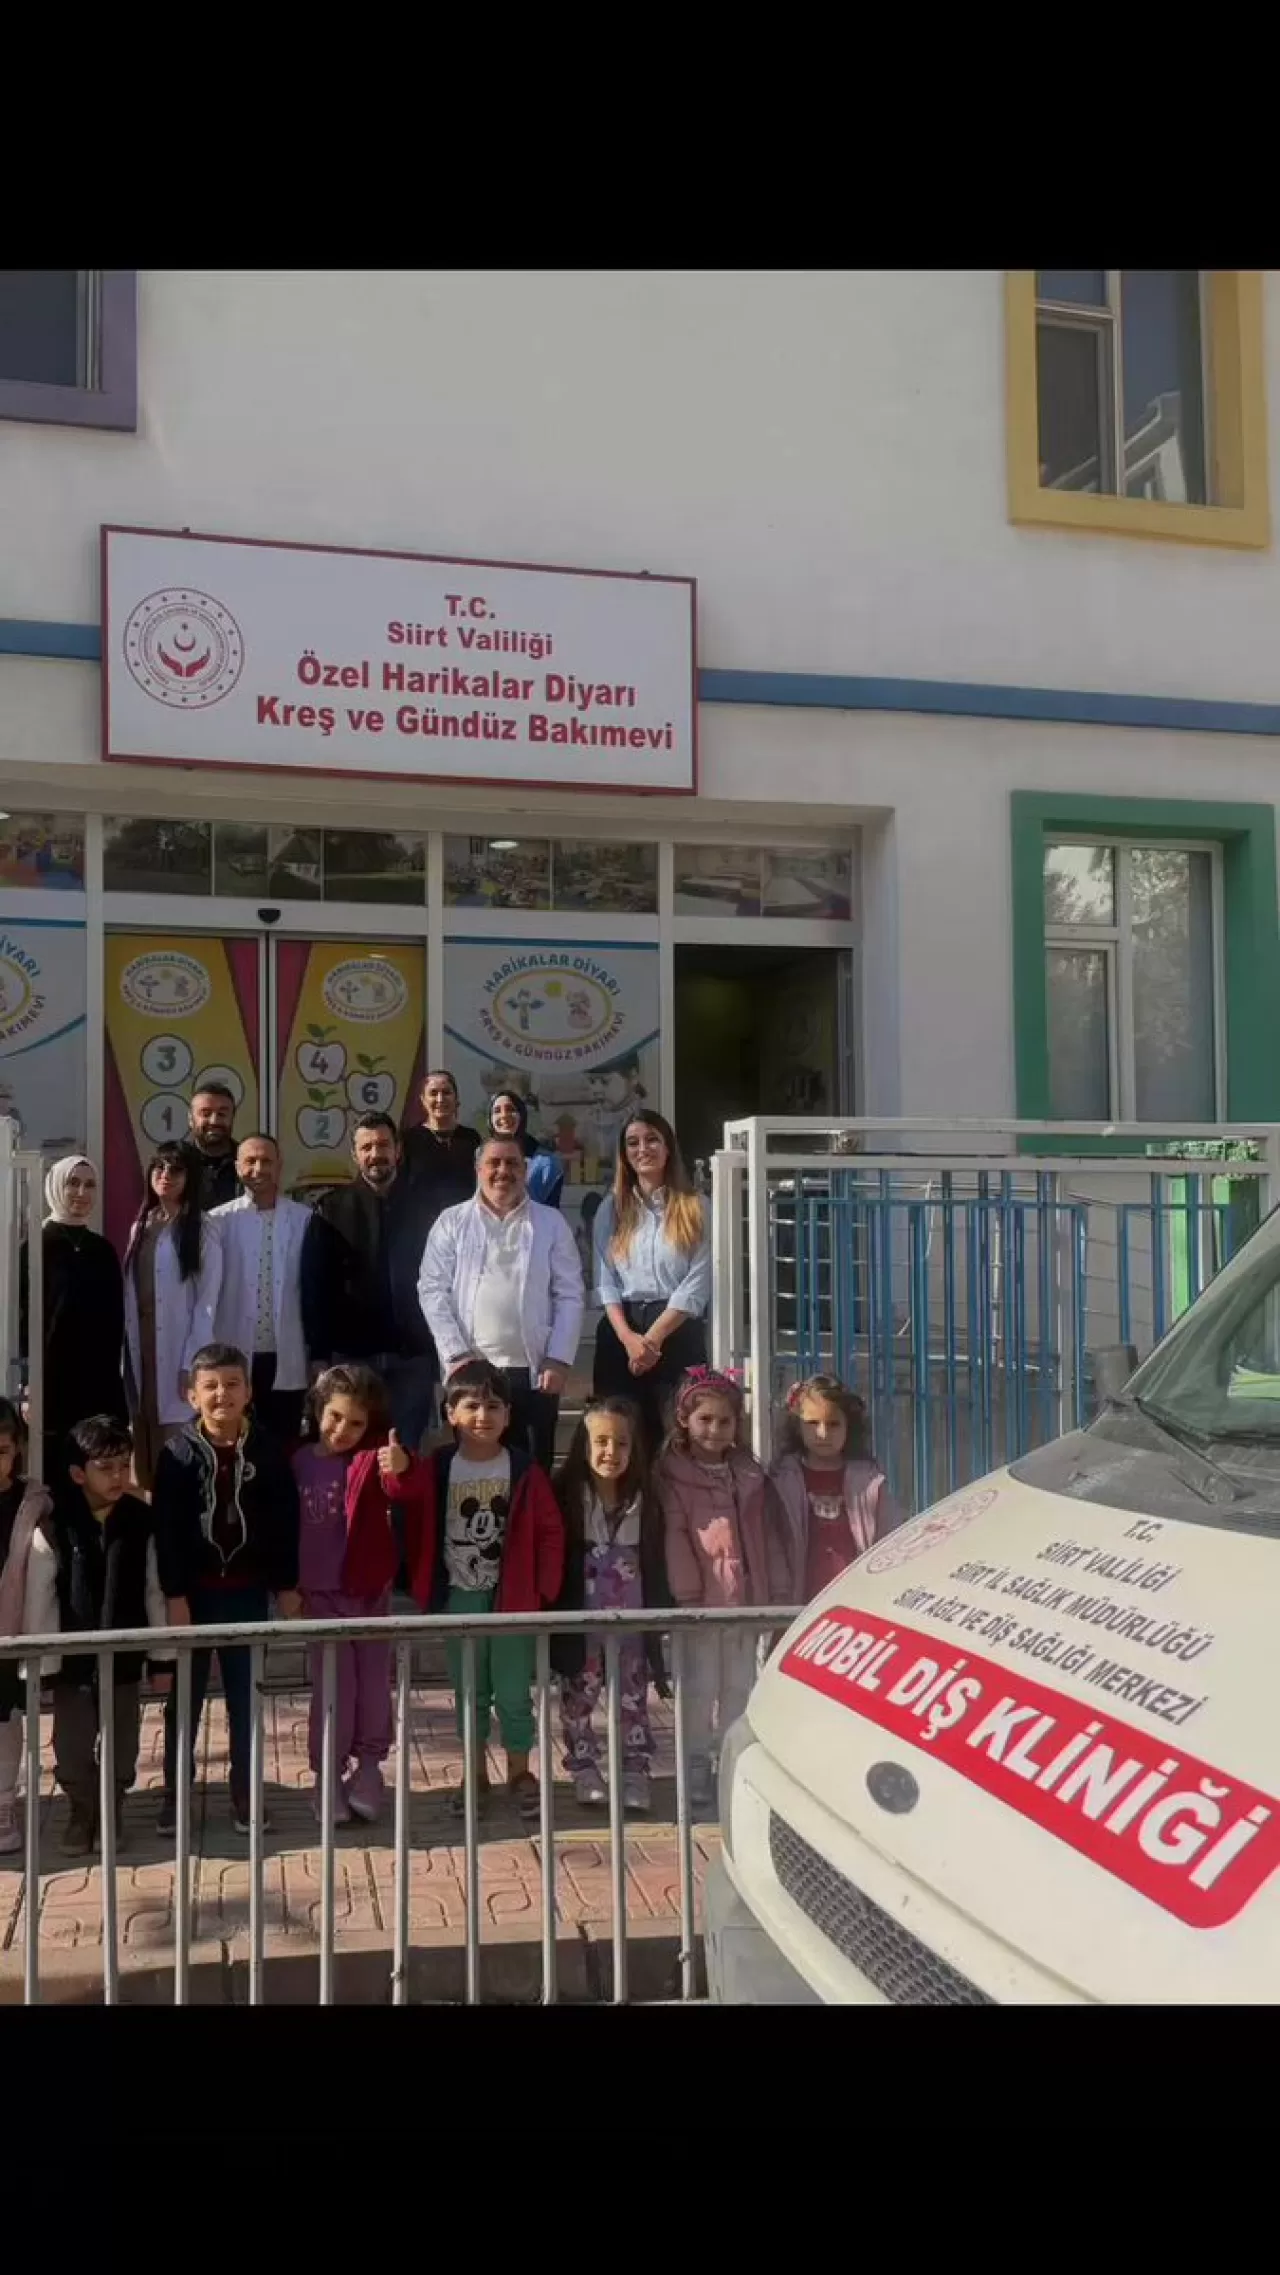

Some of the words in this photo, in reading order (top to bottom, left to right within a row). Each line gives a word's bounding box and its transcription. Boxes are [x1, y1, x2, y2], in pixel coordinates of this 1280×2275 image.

[445, 594, 496, 619] T.C.
[387, 621, 448, 649] Siirt
[457, 626, 553, 660] Valiliği
[297, 650, 370, 691] Özel
[382, 664, 534, 701] Harikalar
[545, 675, 636, 712] Diyarı
[256, 695, 336, 737] Kreş
[348, 710, 384, 734] ve
[397, 704, 517, 741] Gündüz
[528, 714, 674, 750] Bakımevi
[0, 933, 41, 978] İYARI
[483, 953, 570, 993] HARİKALAR
[156, 1046, 177, 1073] 3
[309, 1049, 330, 1076] 4
[361, 1082, 380, 1106] 6
[160, 1106, 173, 1133] 1
[313, 1114, 330, 1140] 2
[1036, 1539, 1093, 1569] SİİRT
[1081, 1548, 1184, 1593] VALİLİĞİ
[950, 1559, 998, 1588] SİİRT
[985, 1565, 1010, 1591] İL
[1001, 1574, 1075, 1610] SAĞLIK
[1064, 1594, 1215, 1662] MÜDÜRLÜĞÜ
[961, 1605, 990, 1632] VE
[979, 1613, 1018, 1647] DİŞ
[1009, 1625, 1095, 1676] SAĞLIĞI
[1081, 1658, 1210, 1727] MERKEZİ
[792, 1617, 900, 1692] MOBİL
[885, 1656, 983, 1741] DİŞ
[966, 1696, 1274, 1891] KLİNİĞİ
